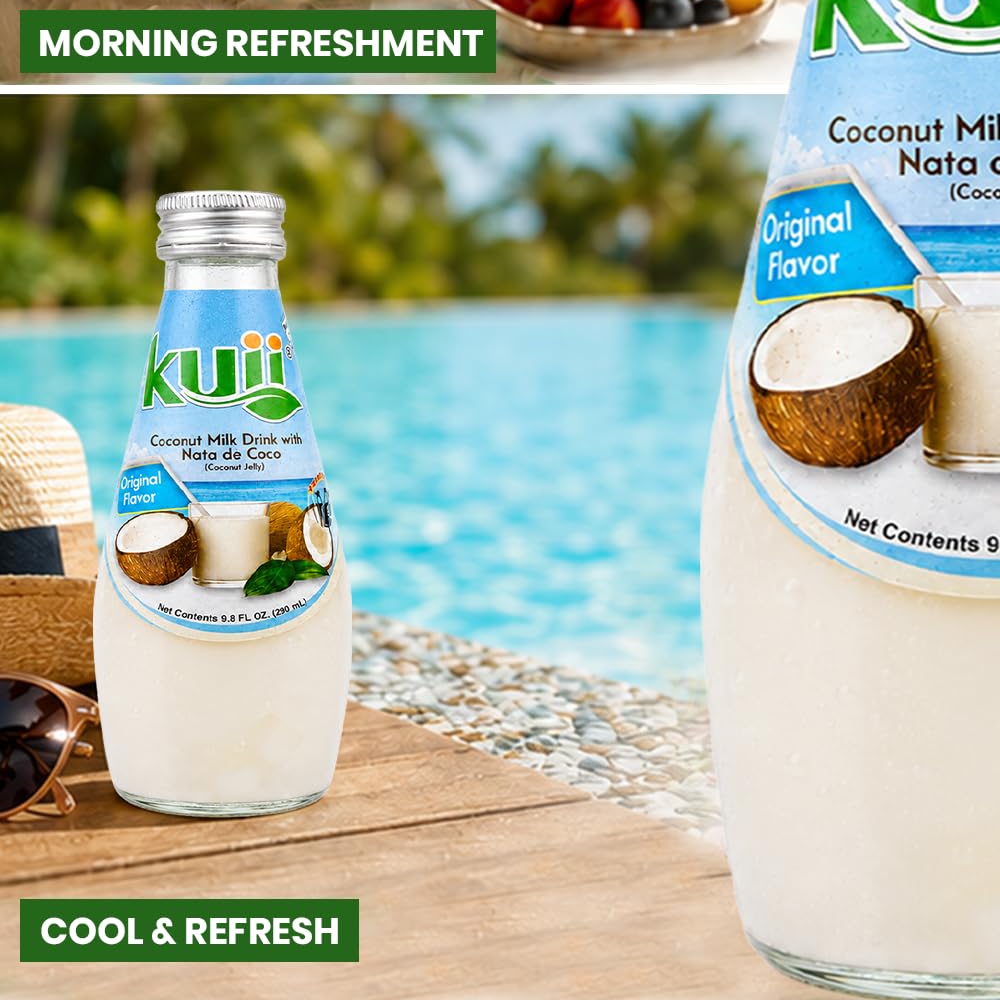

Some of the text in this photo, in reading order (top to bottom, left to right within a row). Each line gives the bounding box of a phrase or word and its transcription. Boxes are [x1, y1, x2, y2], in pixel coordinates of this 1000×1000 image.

[828, 116, 944, 145] Coconut
[899, 148, 978, 176] Nata
[763, 199, 852, 248] Original
[767, 250, 840, 281] Flavor
[142, 331, 286, 409] kuii
[150, 432, 304, 447] Coconut Milk Drink with
[182, 446, 282, 461] Nata de Coco
[204, 462, 266, 472] (Coconut Jelly)
[120, 470, 162, 491] Original
[122, 490, 157, 506] Flavor
[843, 507, 878, 537] Net
[881, 522, 981, 554] Contents
[157, 598, 308, 624] Net Contents 9.8 FL OZ. (290 mL)
